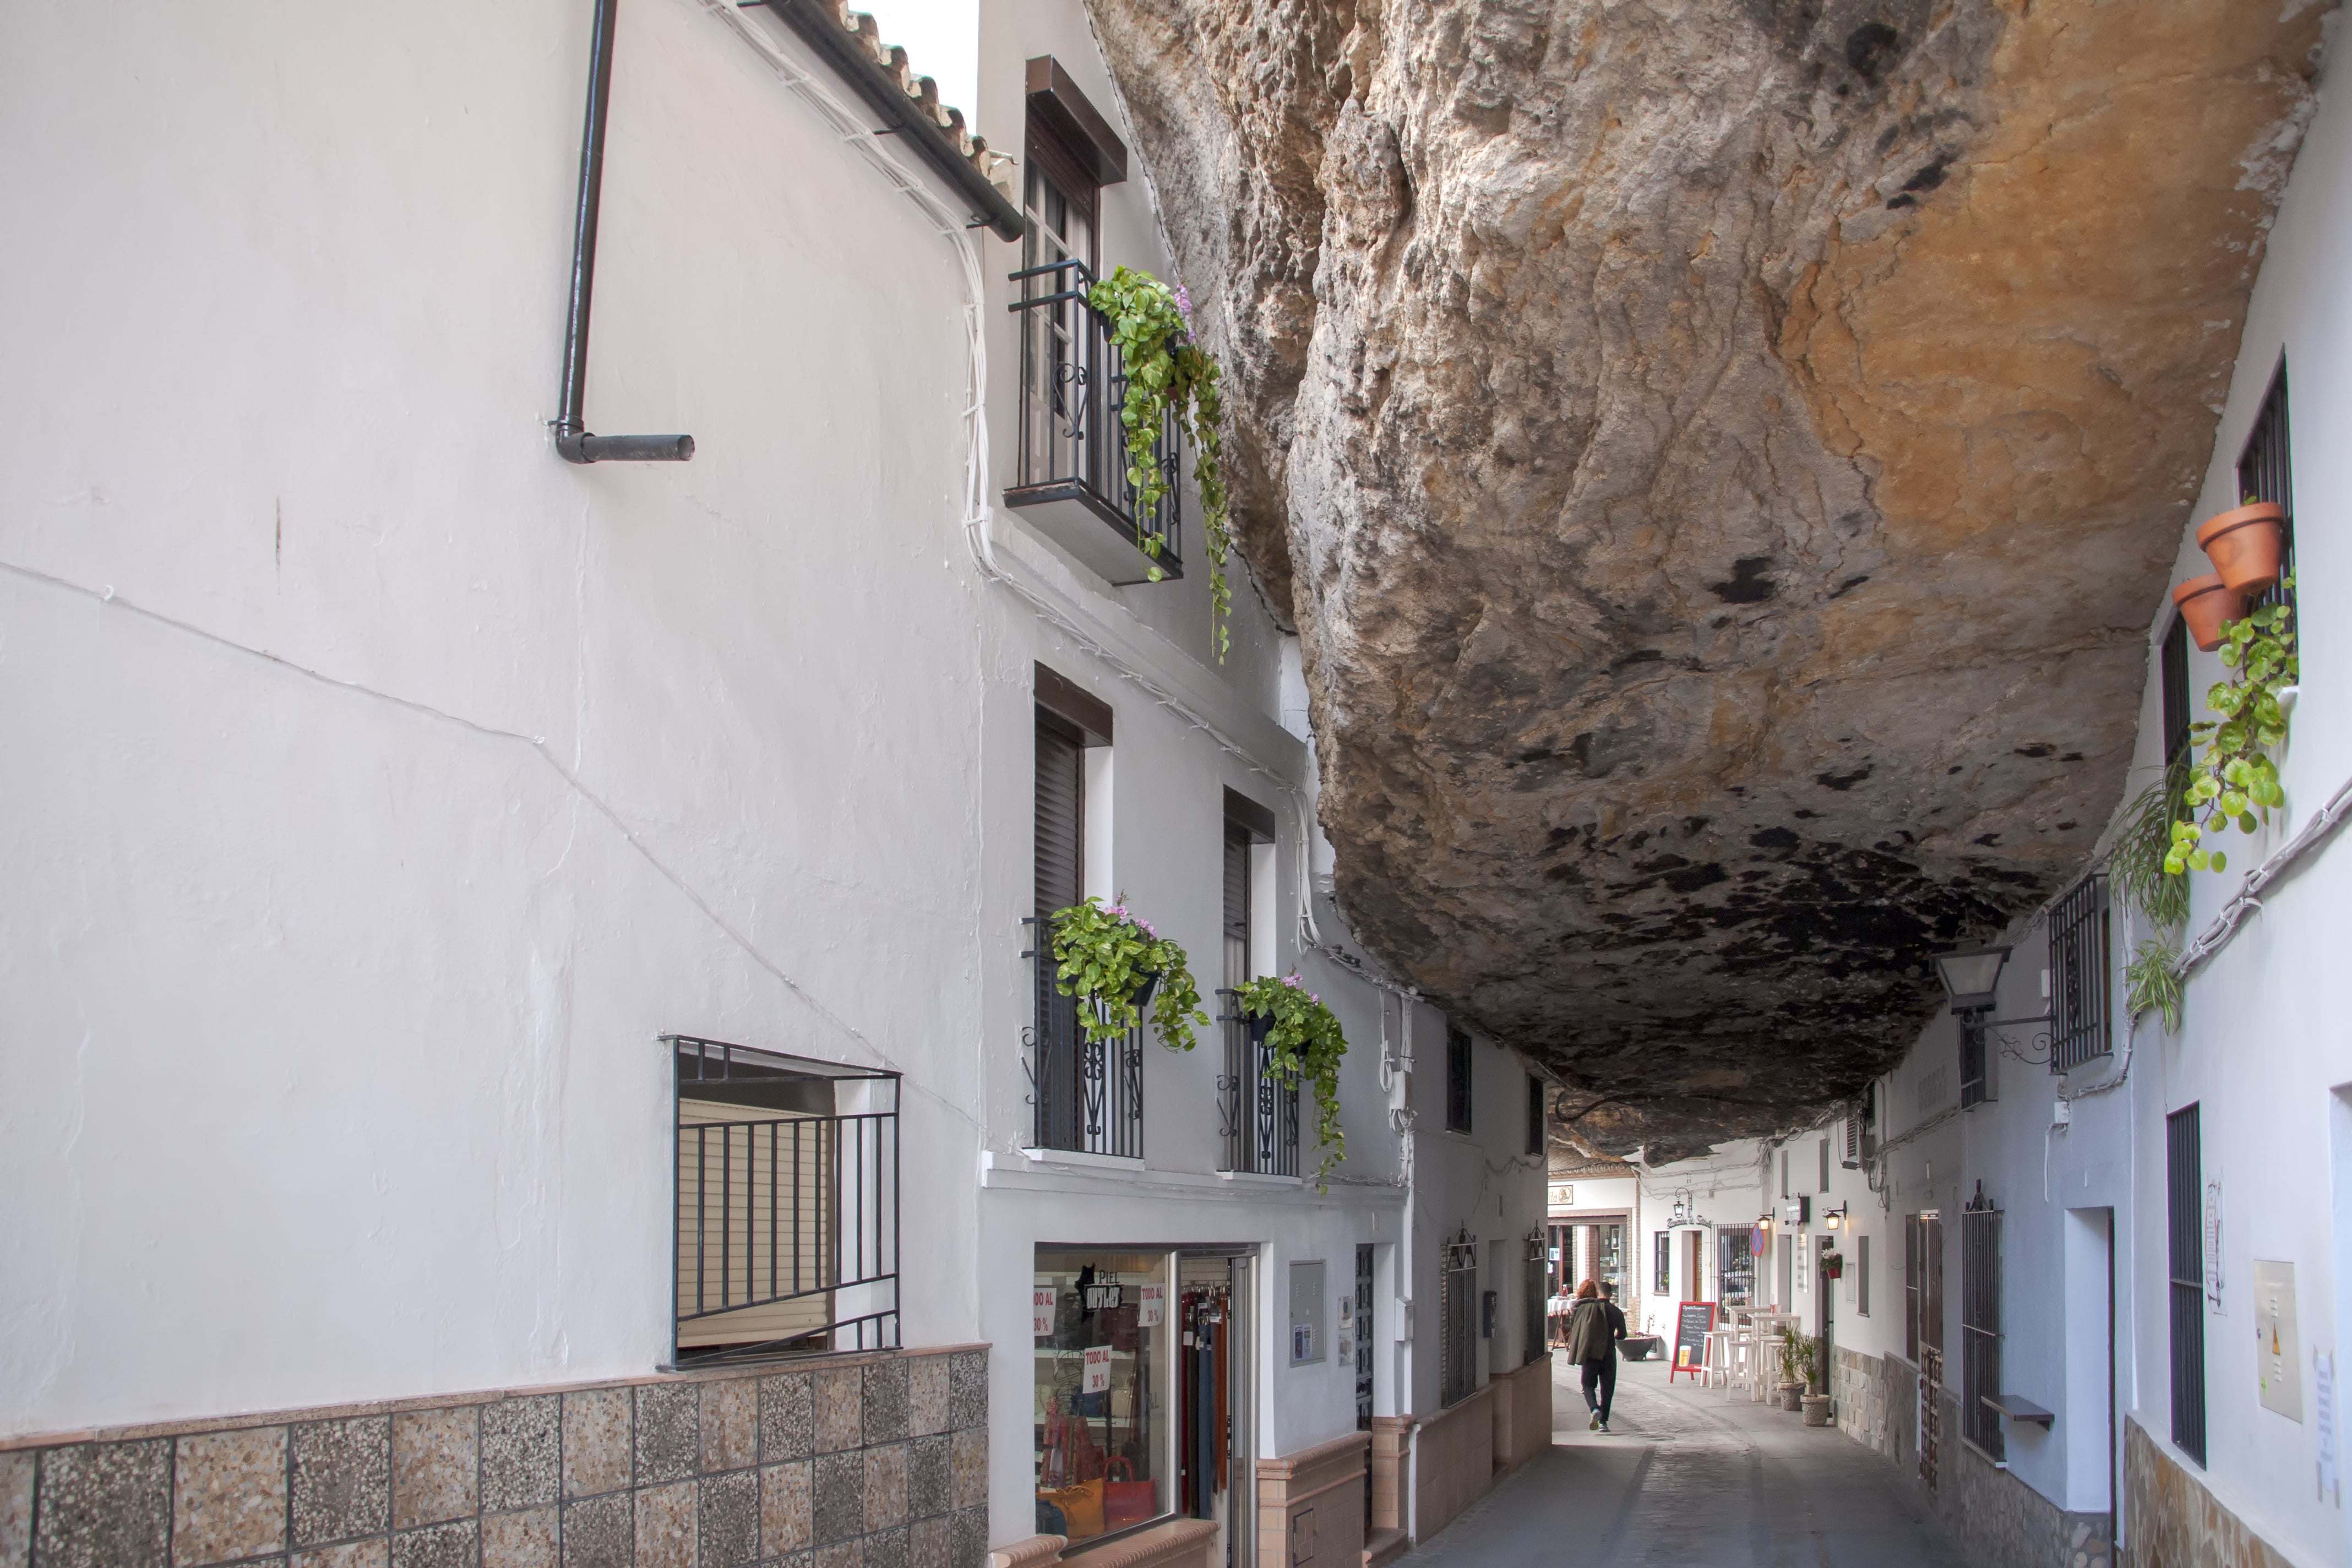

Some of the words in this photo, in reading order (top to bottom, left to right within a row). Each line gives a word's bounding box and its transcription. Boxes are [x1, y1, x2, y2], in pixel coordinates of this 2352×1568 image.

[1046, 1292, 1053, 1305] AL
[1142, 1287, 1154, 1300] TODO
[1156, 1287, 1163, 1299] AL
[1147, 1309, 1153, 1322] 30
[1086, 1351, 1101, 1365] TODO
[1102, 1350, 1109, 1362] AL
[1092, 1375, 1098, 1388] 30
